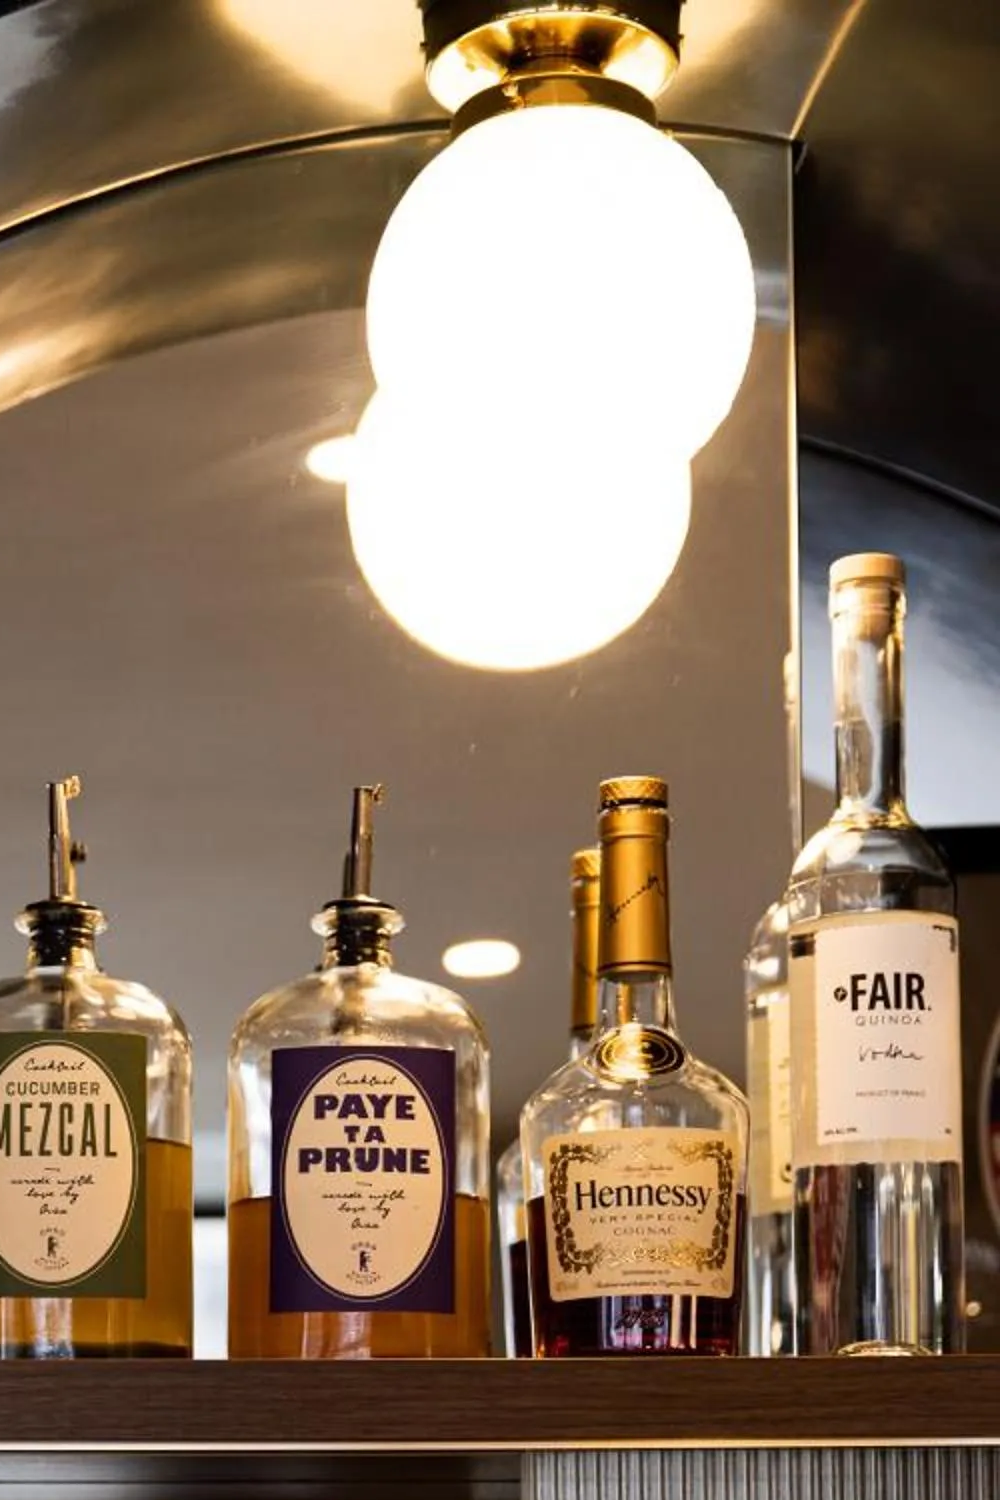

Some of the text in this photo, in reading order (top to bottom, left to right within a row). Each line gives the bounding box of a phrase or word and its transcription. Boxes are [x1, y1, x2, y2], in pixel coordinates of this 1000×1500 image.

[856, 1015, 922, 1027] QUINOA
[5, 1081, 101, 1097] CUCUMBER
[314, 1093, 416, 1120] PAYE
[344, 1125, 386, 1143] TA
[298, 1147, 430, 1174] PRUNE
[574, 1180, 713, 1214] Hennessy
[589, 1212, 699, 1225] VERY SPECIAL
[613, 1226, 676, 1236] COGNAC
